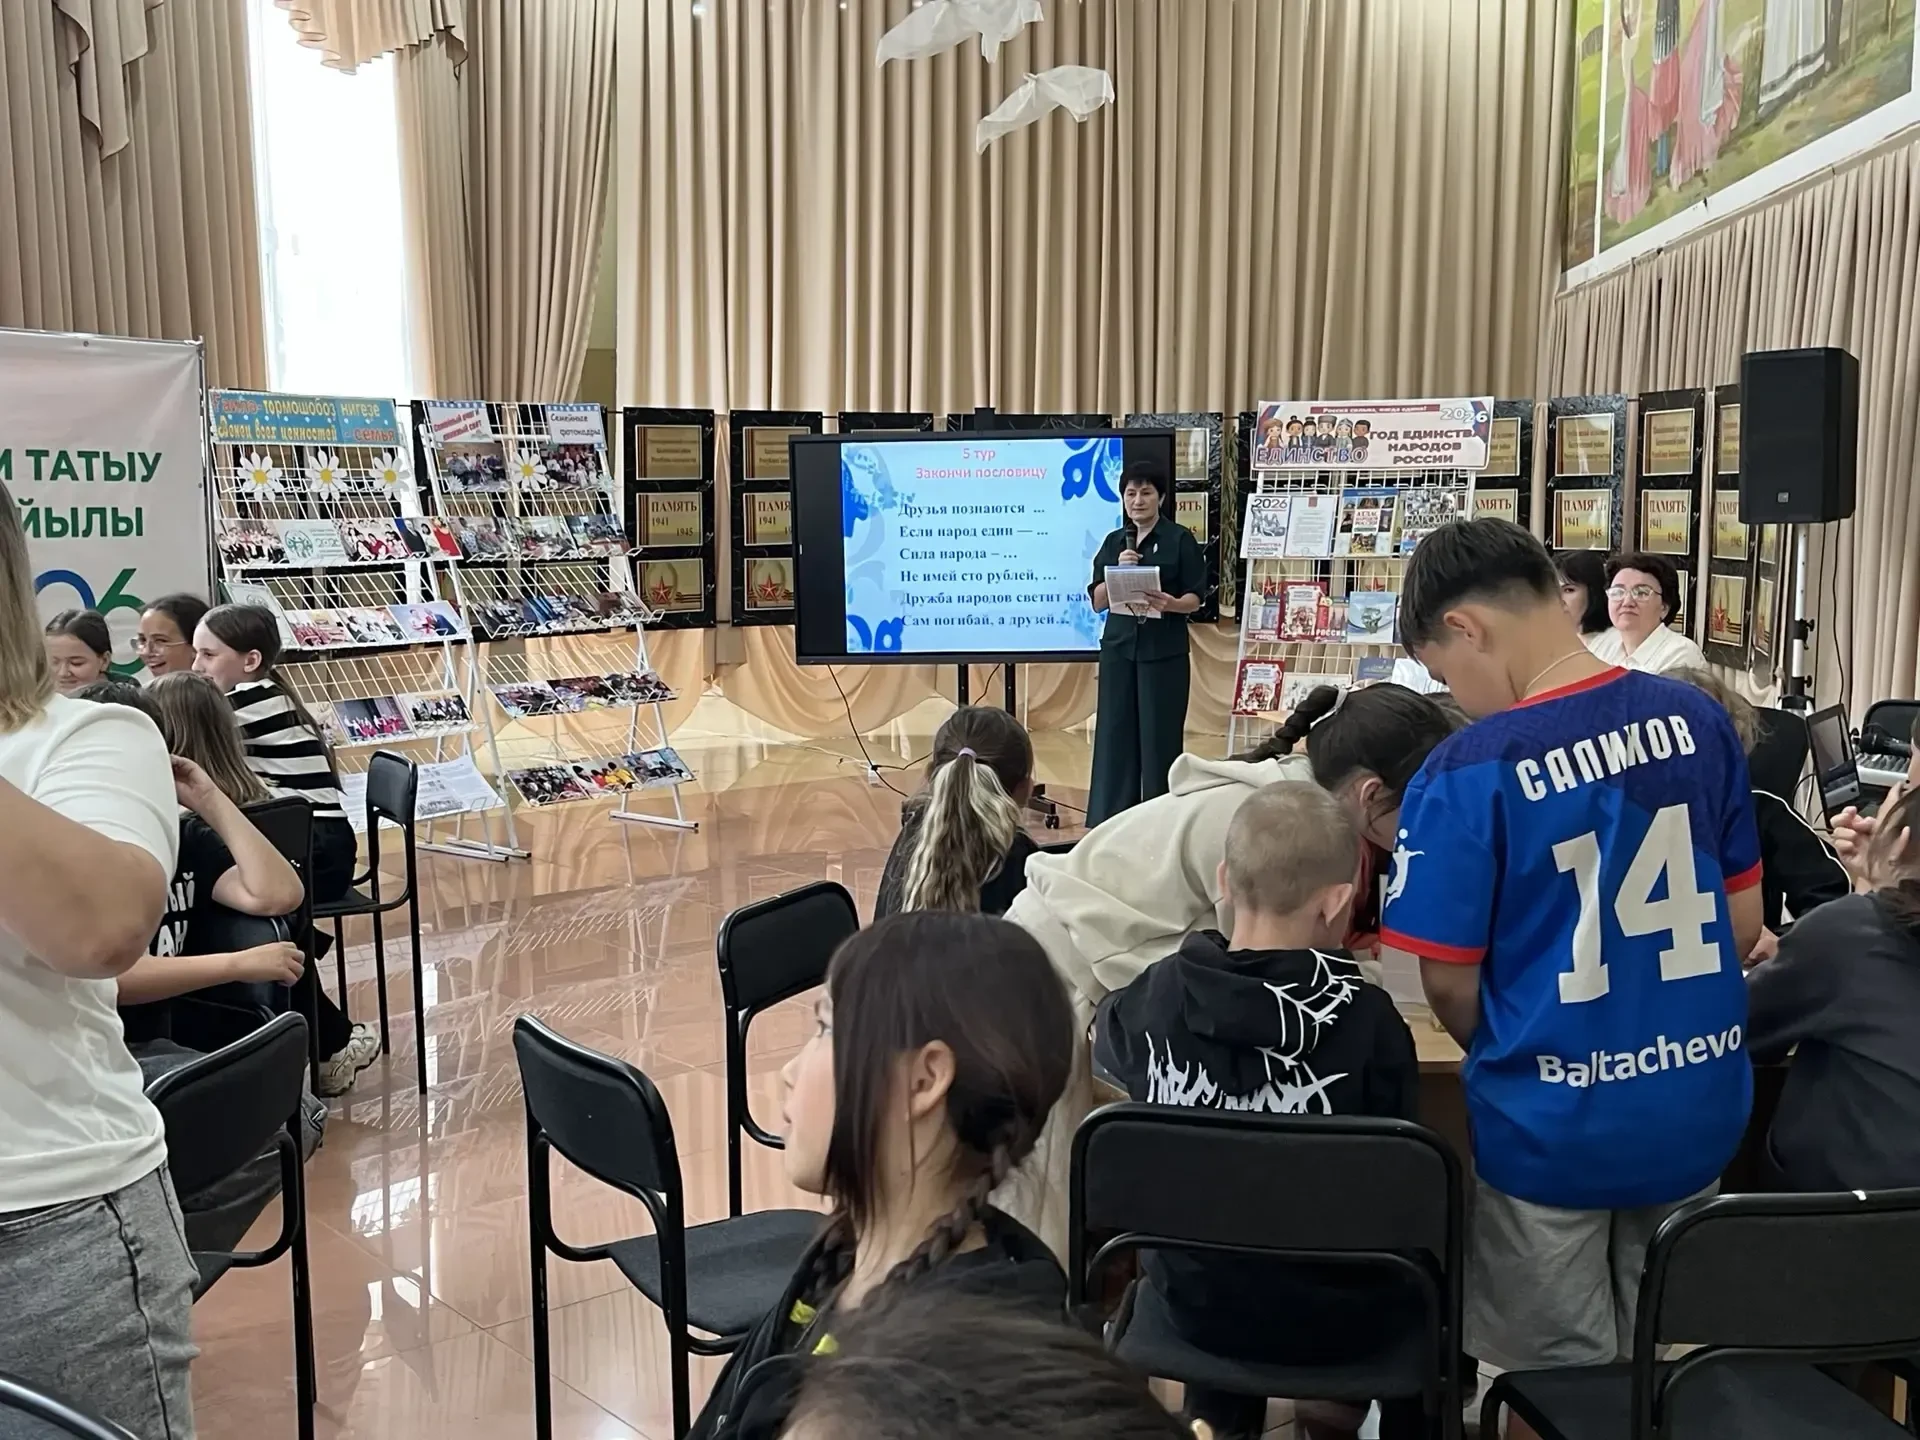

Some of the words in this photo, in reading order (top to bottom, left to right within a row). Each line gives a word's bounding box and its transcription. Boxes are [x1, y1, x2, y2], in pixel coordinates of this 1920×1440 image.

[1440, 407, 1488, 424] 2026
[255, 418, 277, 439] всех
[281, 424, 338, 441] ценностей
[354, 428, 396, 442] семья
[1370, 431, 1398, 441] ГОД
[1388, 442, 1462, 452] НАРОДОВ
[963, 448, 970, 459] 5
[974, 449, 996, 461] тур
[1256, 448, 1369, 466] ЕДИНСТВО
[1393, 455, 1454, 465] РОССИИ
[26, 449, 162, 483] ТАТЫУ
[916, 468, 971, 479] Закончи
[975, 468, 1047, 480] пословицу
[651, 501, 697, 512] ПАМЯТЬ
[758, 500, 790, 511] ПАМЯ
[1253, 498, 1288, 509] 2026
[1649, 500, 1687, 513] ПАМЯТЬ
[898, 503, 947, 518] Друзья
[952, 504, 1025, 515] познаются
[652, 516, 669, 526] 1941
[759, 516, 776, 525] 1941
[1564, 516, 1579, 527] 1941
[676, 527, 694, 537] 1945
[900, 526, 933, 538] Если
[937, 527, 977, 540] народ
[981, 526, 1013, 538] един
[1586, 528, 1602, 540] 1945
[1667, 531, 1683, 543] 1945
[900, 548, 935, 560] Сила
[940, 549, 987, 562] народа
[901, 571, 919, 582] Не
[923, 570, 957, 582] имей
[961, 572, 983, 582] сто
[987, 570, 1039, 584] рублей,
[902, 592, 952, 607] Дружба
[957, 593, 1012, 606] народов
[1016, 593, 1061, 603] светит
[902, 615, 930, 626] Сам
[934, 614, 994, 627] погибай,
[998, 616, 1005, 625] а
[1552, 803, 1722, 1005] 14
[1536, 1024, 1743, 1089] Baltachevo
